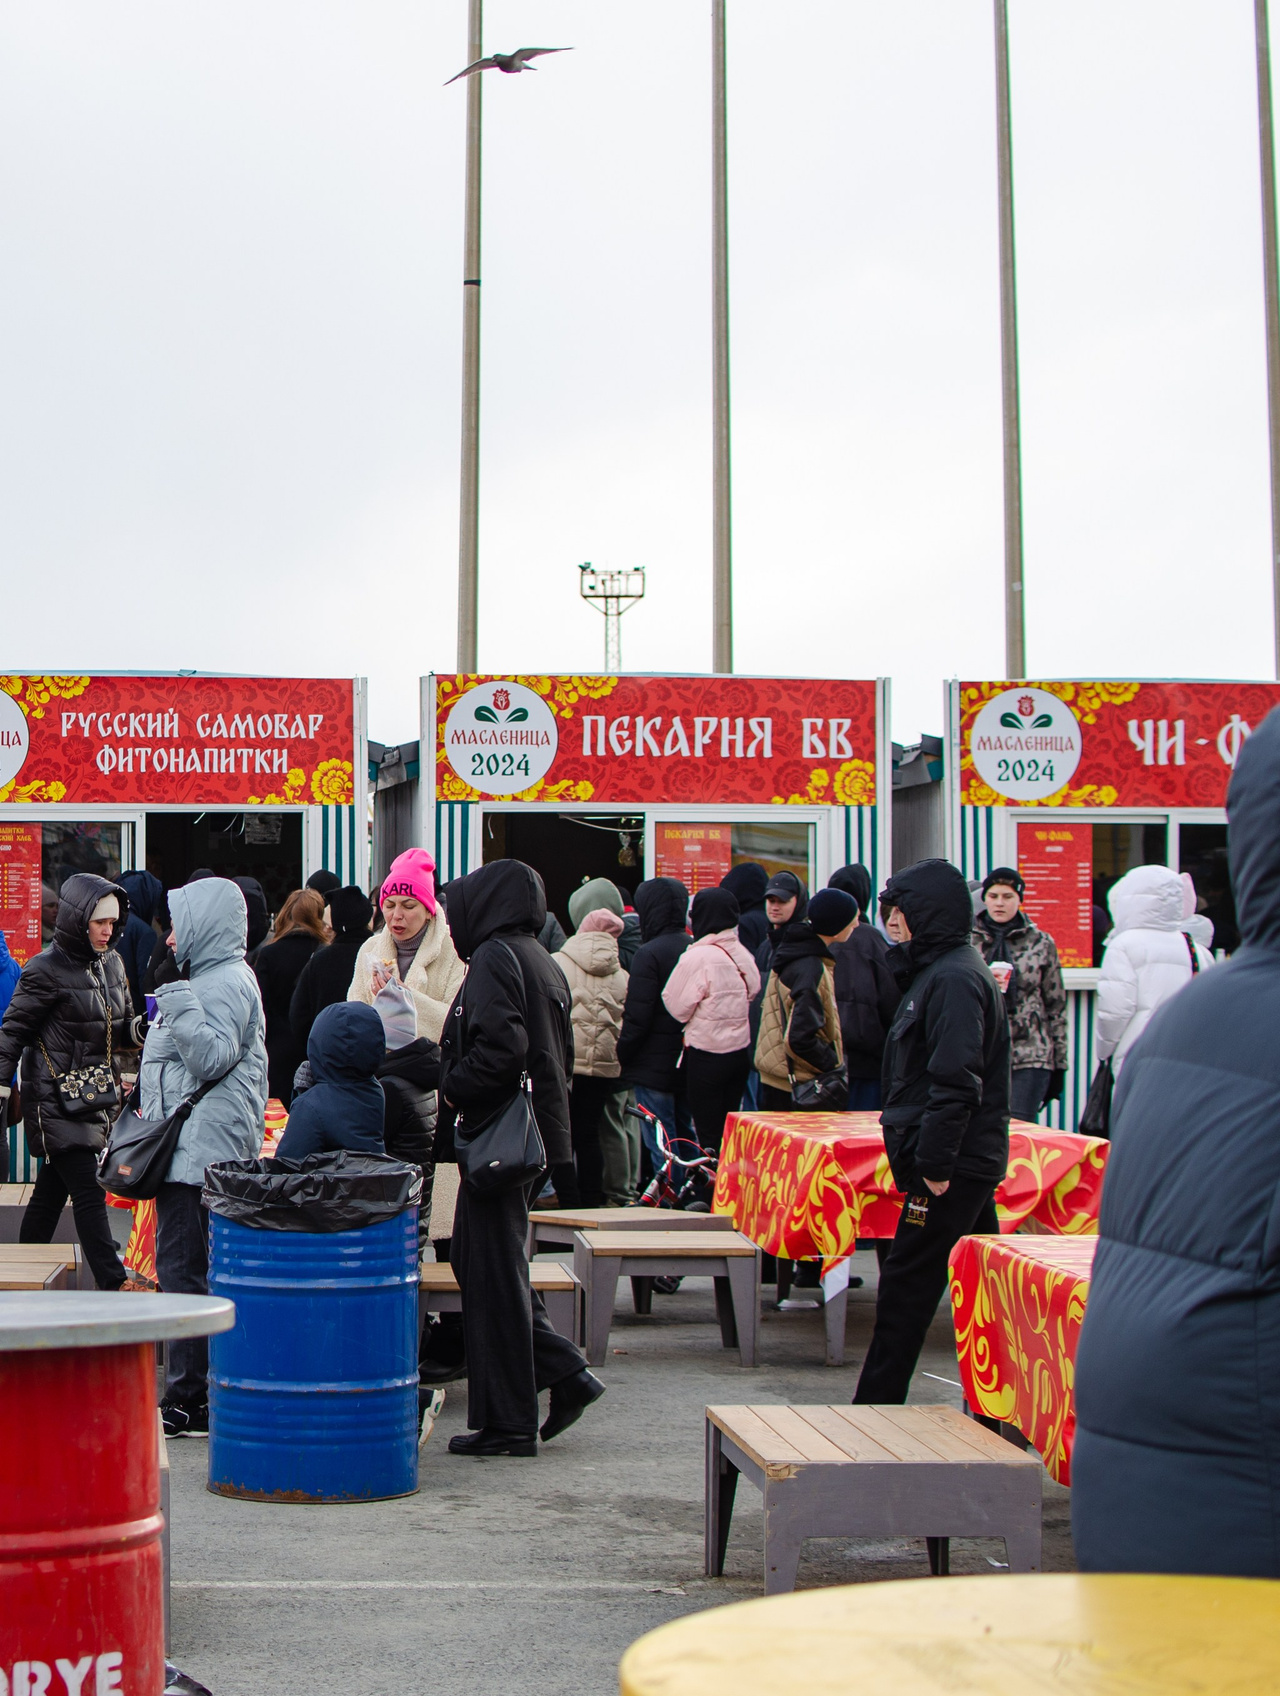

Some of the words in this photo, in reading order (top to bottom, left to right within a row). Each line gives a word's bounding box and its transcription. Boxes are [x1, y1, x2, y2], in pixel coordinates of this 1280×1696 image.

[61, 708, 180, 738] РУССКИЙ
[196, 713, 324, 740] САМОВАР
[451, 729, 551, 748] МАСЛЕНИЦА
[582, 715, 773, 759] ПЕКАРНЯ
[801, 718, 853, 759] БВ
[977, 736, 1075, 753] МАСЛЕНИЦА
[95, 744, 289, 776] ФИТОНАПИТКИ
[470, 752, 531, 777] 2024
[997, 759, 1055, 781] 2024
[382, 882, 417, 898] KARL
